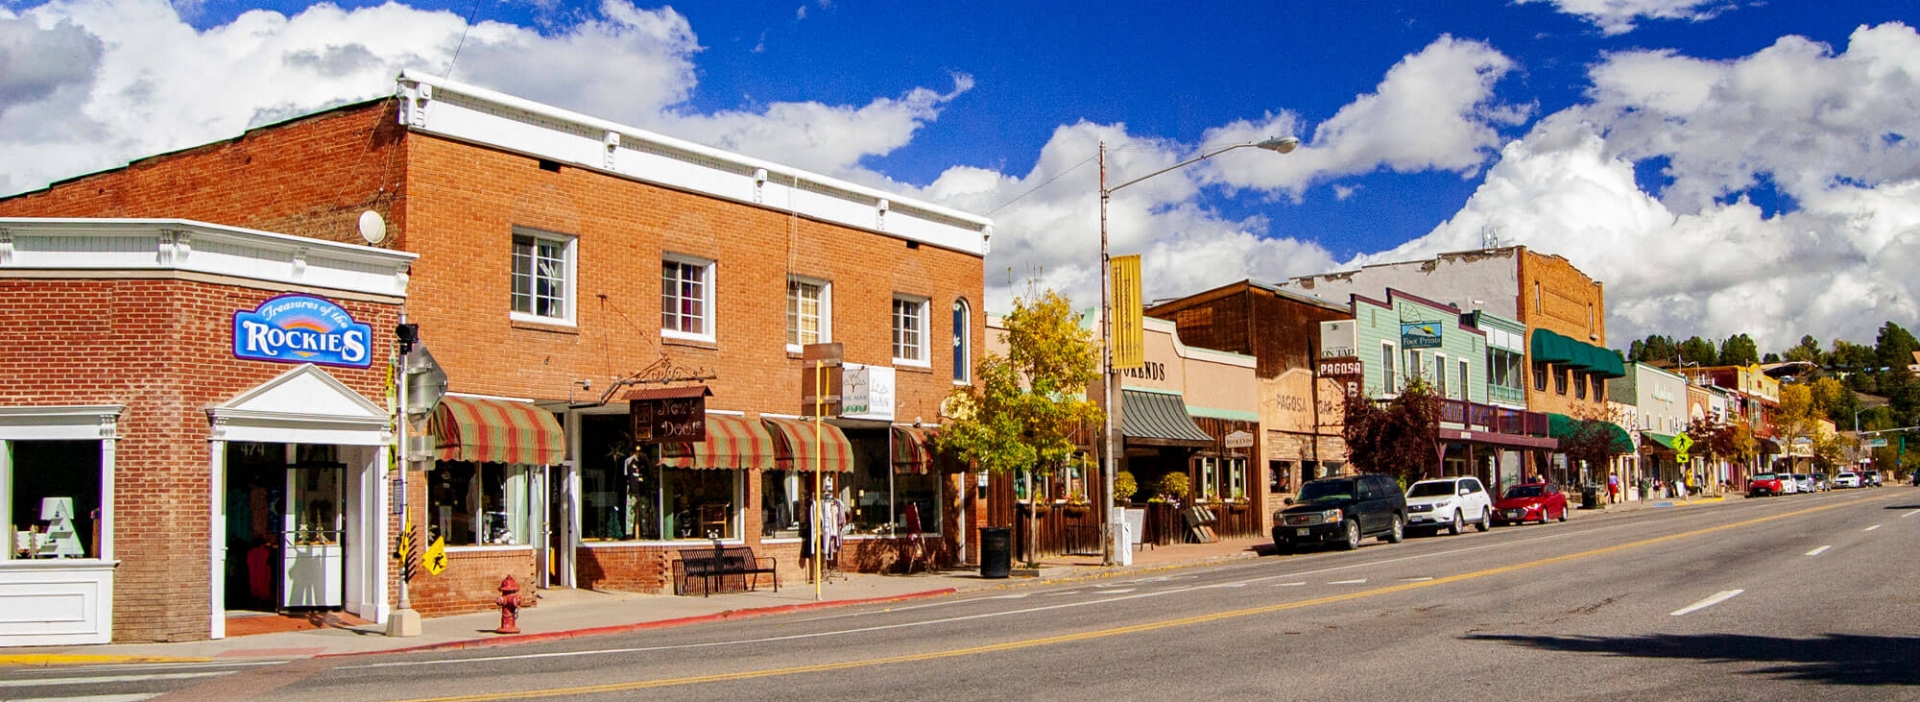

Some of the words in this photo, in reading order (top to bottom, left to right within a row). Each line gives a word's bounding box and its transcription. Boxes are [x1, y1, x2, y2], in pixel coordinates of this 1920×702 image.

[262, 301, 318, 321] Treasures
[320, 305, 336, 317] of
[331, 312, 348, 329] the
[242, 320, 365, 362] ROCKIES
[1321, 350, 1335, 358] ON
[1320, 362, 1361, 375] PAGOSA
[1276, 394, 1308, 413] PAGOSA
[1318, 400, 1333, 415] BAR
[661, 421, 701, 437] Door
[240, 443, 265, 456] 474
